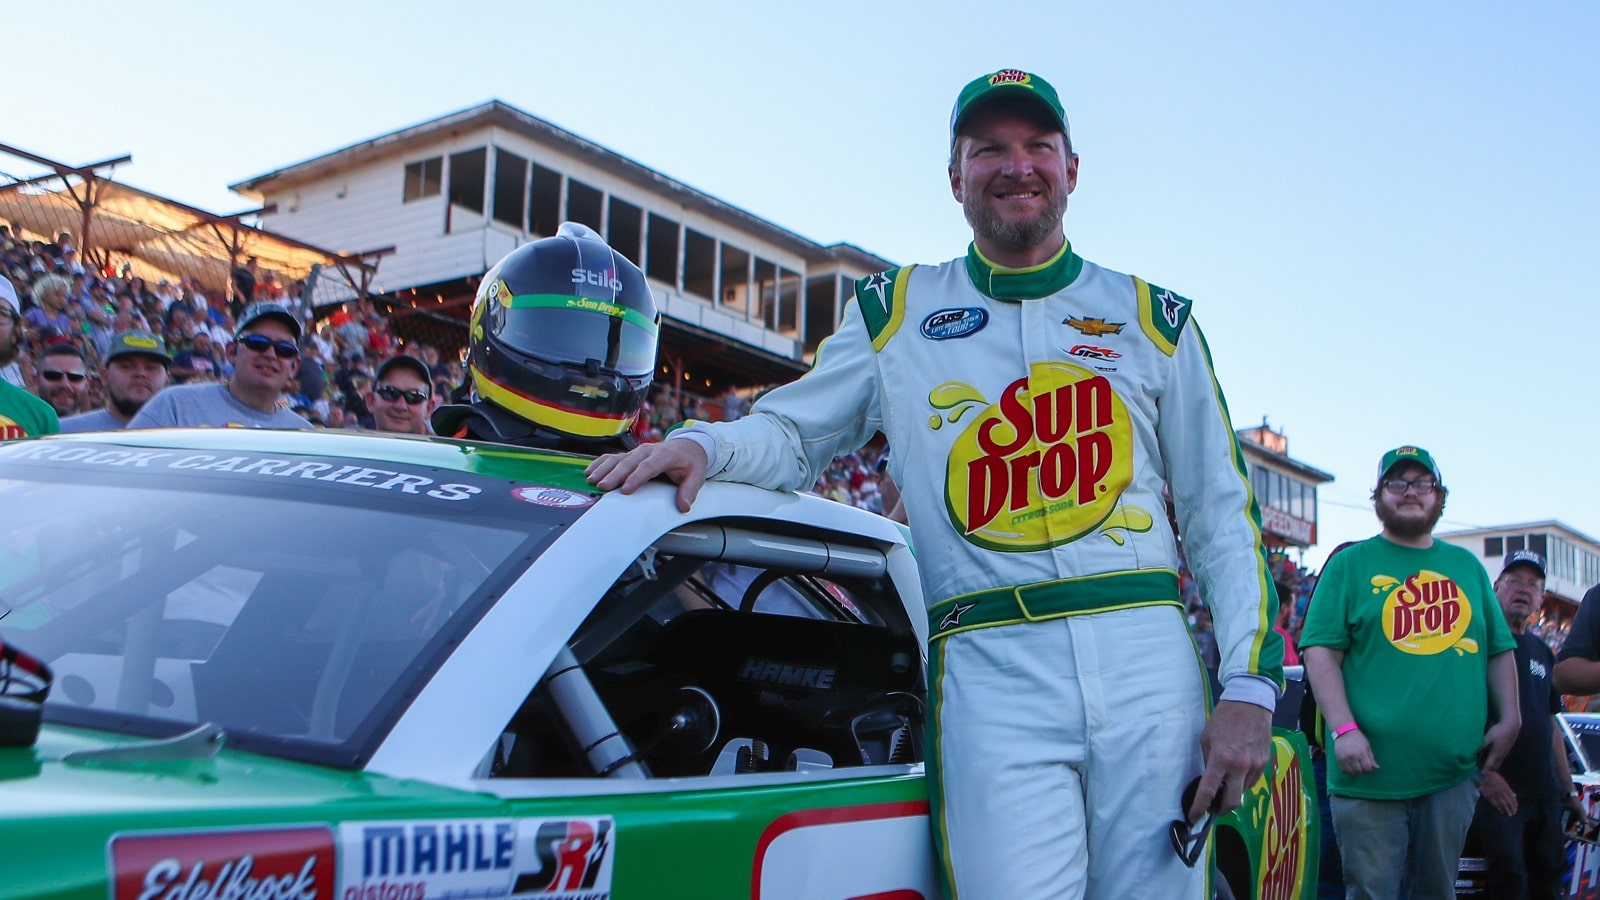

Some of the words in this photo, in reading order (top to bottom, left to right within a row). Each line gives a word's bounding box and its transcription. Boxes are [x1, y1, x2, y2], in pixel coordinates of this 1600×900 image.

[992, 71, 1026, 85] Drop
[571, 268, 623, 292] Stilo
[577, 297, 598, 309] Sun
[599, 302, 620, 316] Drop
[977, 375, 1114, 458] Sun
[168, 454, 483, 501] CARRIERS
[966, 431, 1113, 534] Drop
[1011, 505, 1048, 526] CITRUS
[1048, 499, 1074, 515] SODA
[1396, 573, 1459, 608] Sun
[1392, 600, 1460, 642] Drop
[743, 660, 836, 689] HAMKE
[1267, 750, 1301, 872] Sun
[363, 822, 514, 878] MAHLE
[136, 854, 318, 900] Edelbrock
